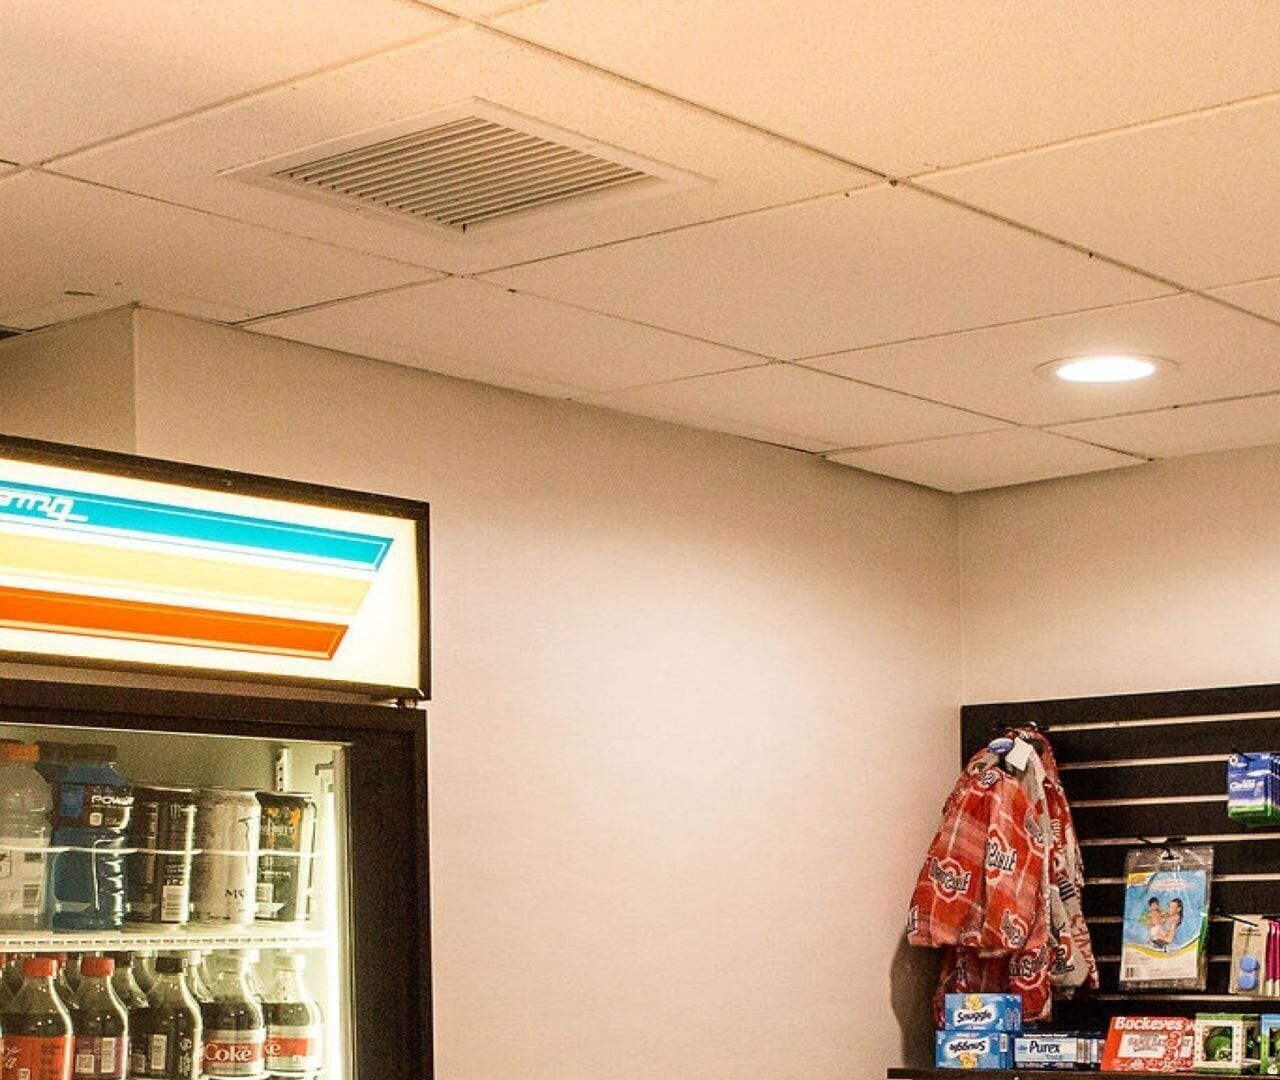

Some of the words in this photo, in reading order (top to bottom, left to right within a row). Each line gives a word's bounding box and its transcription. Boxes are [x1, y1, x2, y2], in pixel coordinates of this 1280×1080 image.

[956, 1010, 993, 1023] Snuggle
[205, 1042, 252, 1062] Coke
[264, 1040, 282, 1057] ke
[1028, 1040, 1061, 1055] Purex
